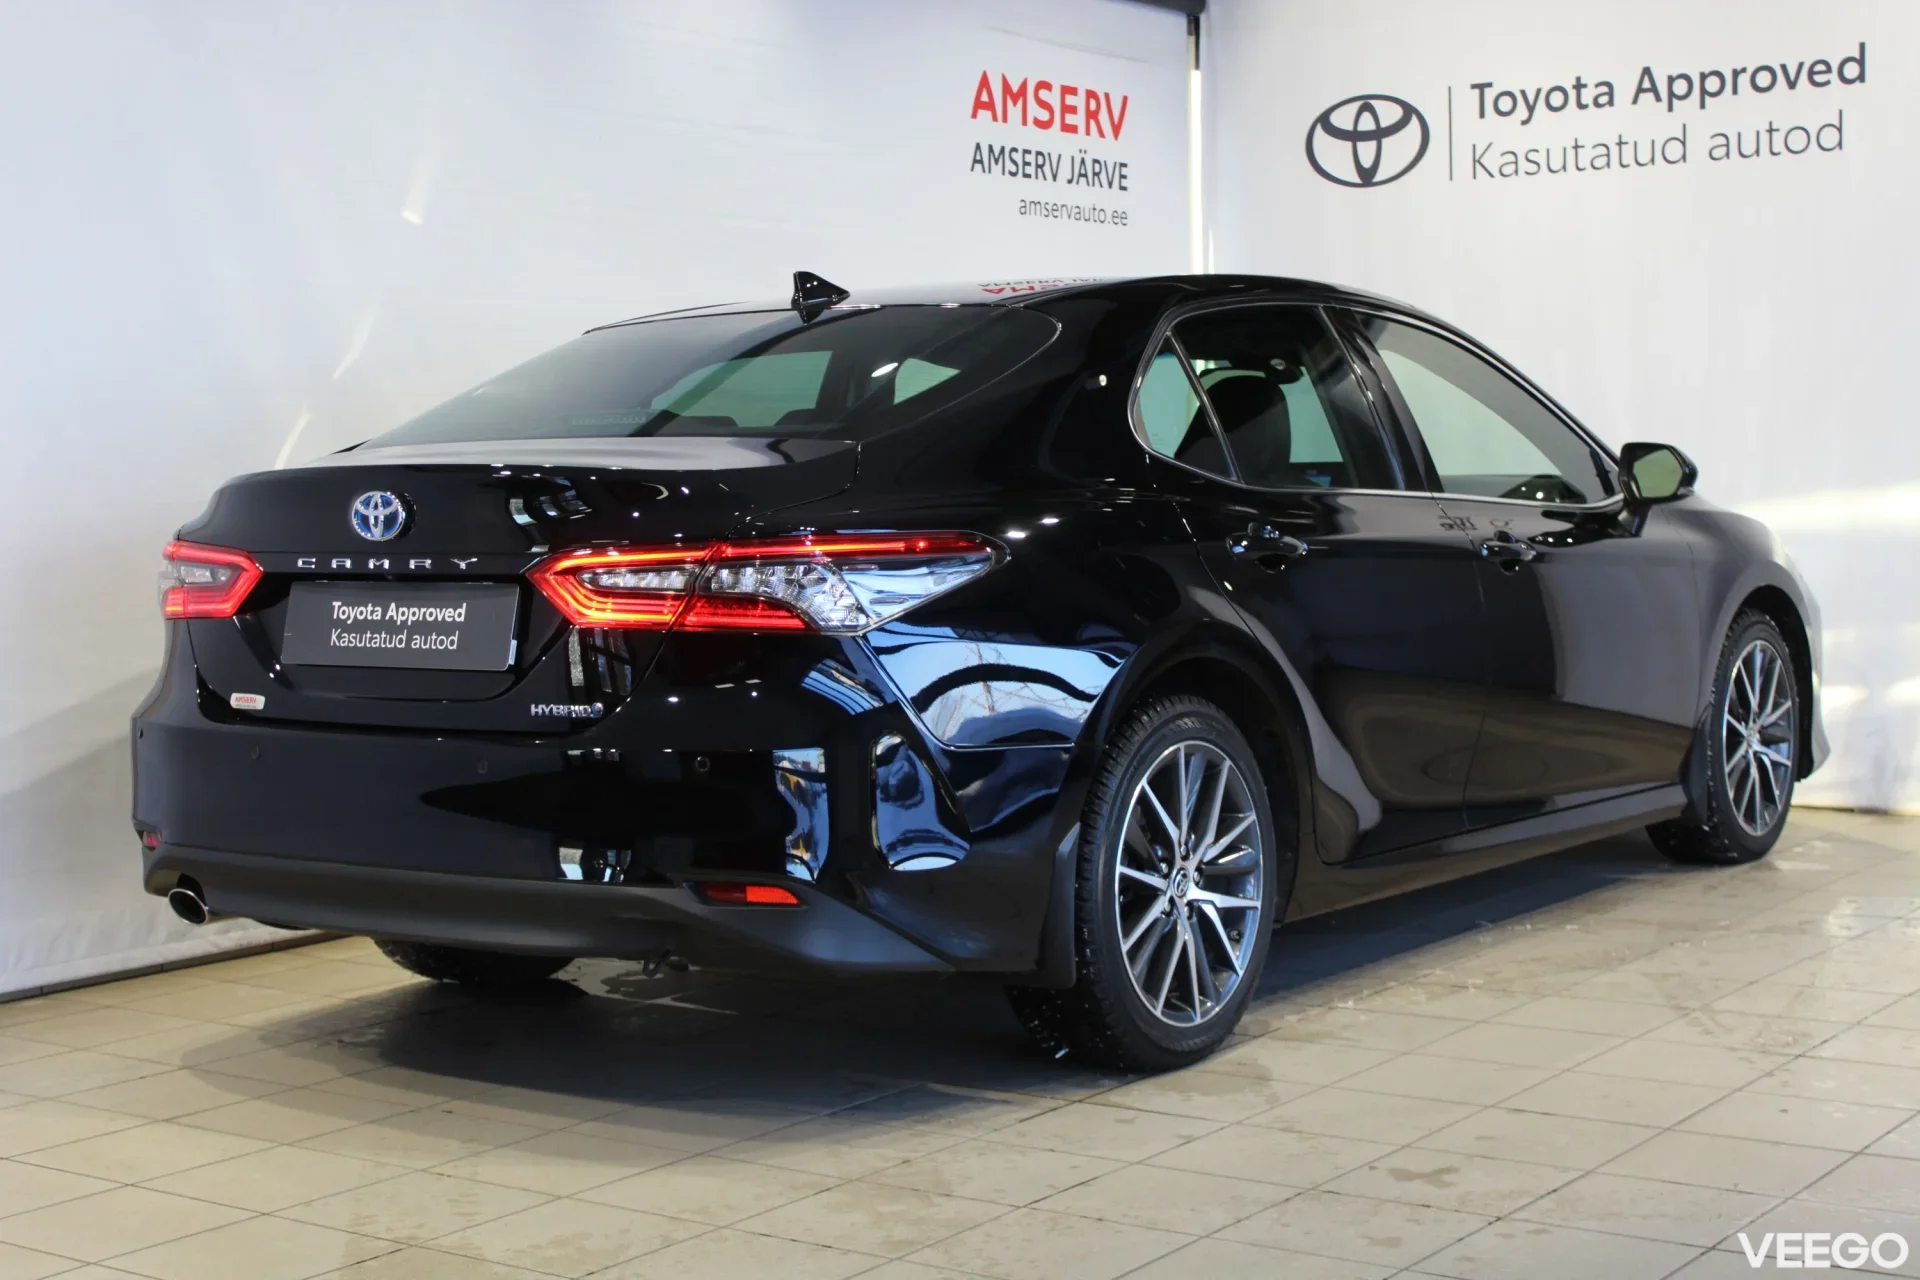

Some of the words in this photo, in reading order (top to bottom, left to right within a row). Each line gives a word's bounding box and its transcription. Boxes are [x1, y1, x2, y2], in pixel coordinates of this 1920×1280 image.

[1470, 75, 1615, 126] Toyota
[1631, 41, 1867, 113] Approved
[970, 69, 1128, 141] AMSERV
[1471, 123, 1688, 180] Kasutatud
[1708, 109, 1844, 162] autod
[970, 142, 1062, 182] AMSERV
[1066, 148, 1129, 191] JÄRVE
[1018, 198, 1129, 226] amservauto.ee
[297, 557, 478, 570] CAMRY
[332, 601, 382, 624] Toyota
[385, 602, 467, 626] Approved
[330, 628, 408, 648] Kasutatud
[411, 630, 459, 650] autod
[530, 703, 592, 718] HYBRID
